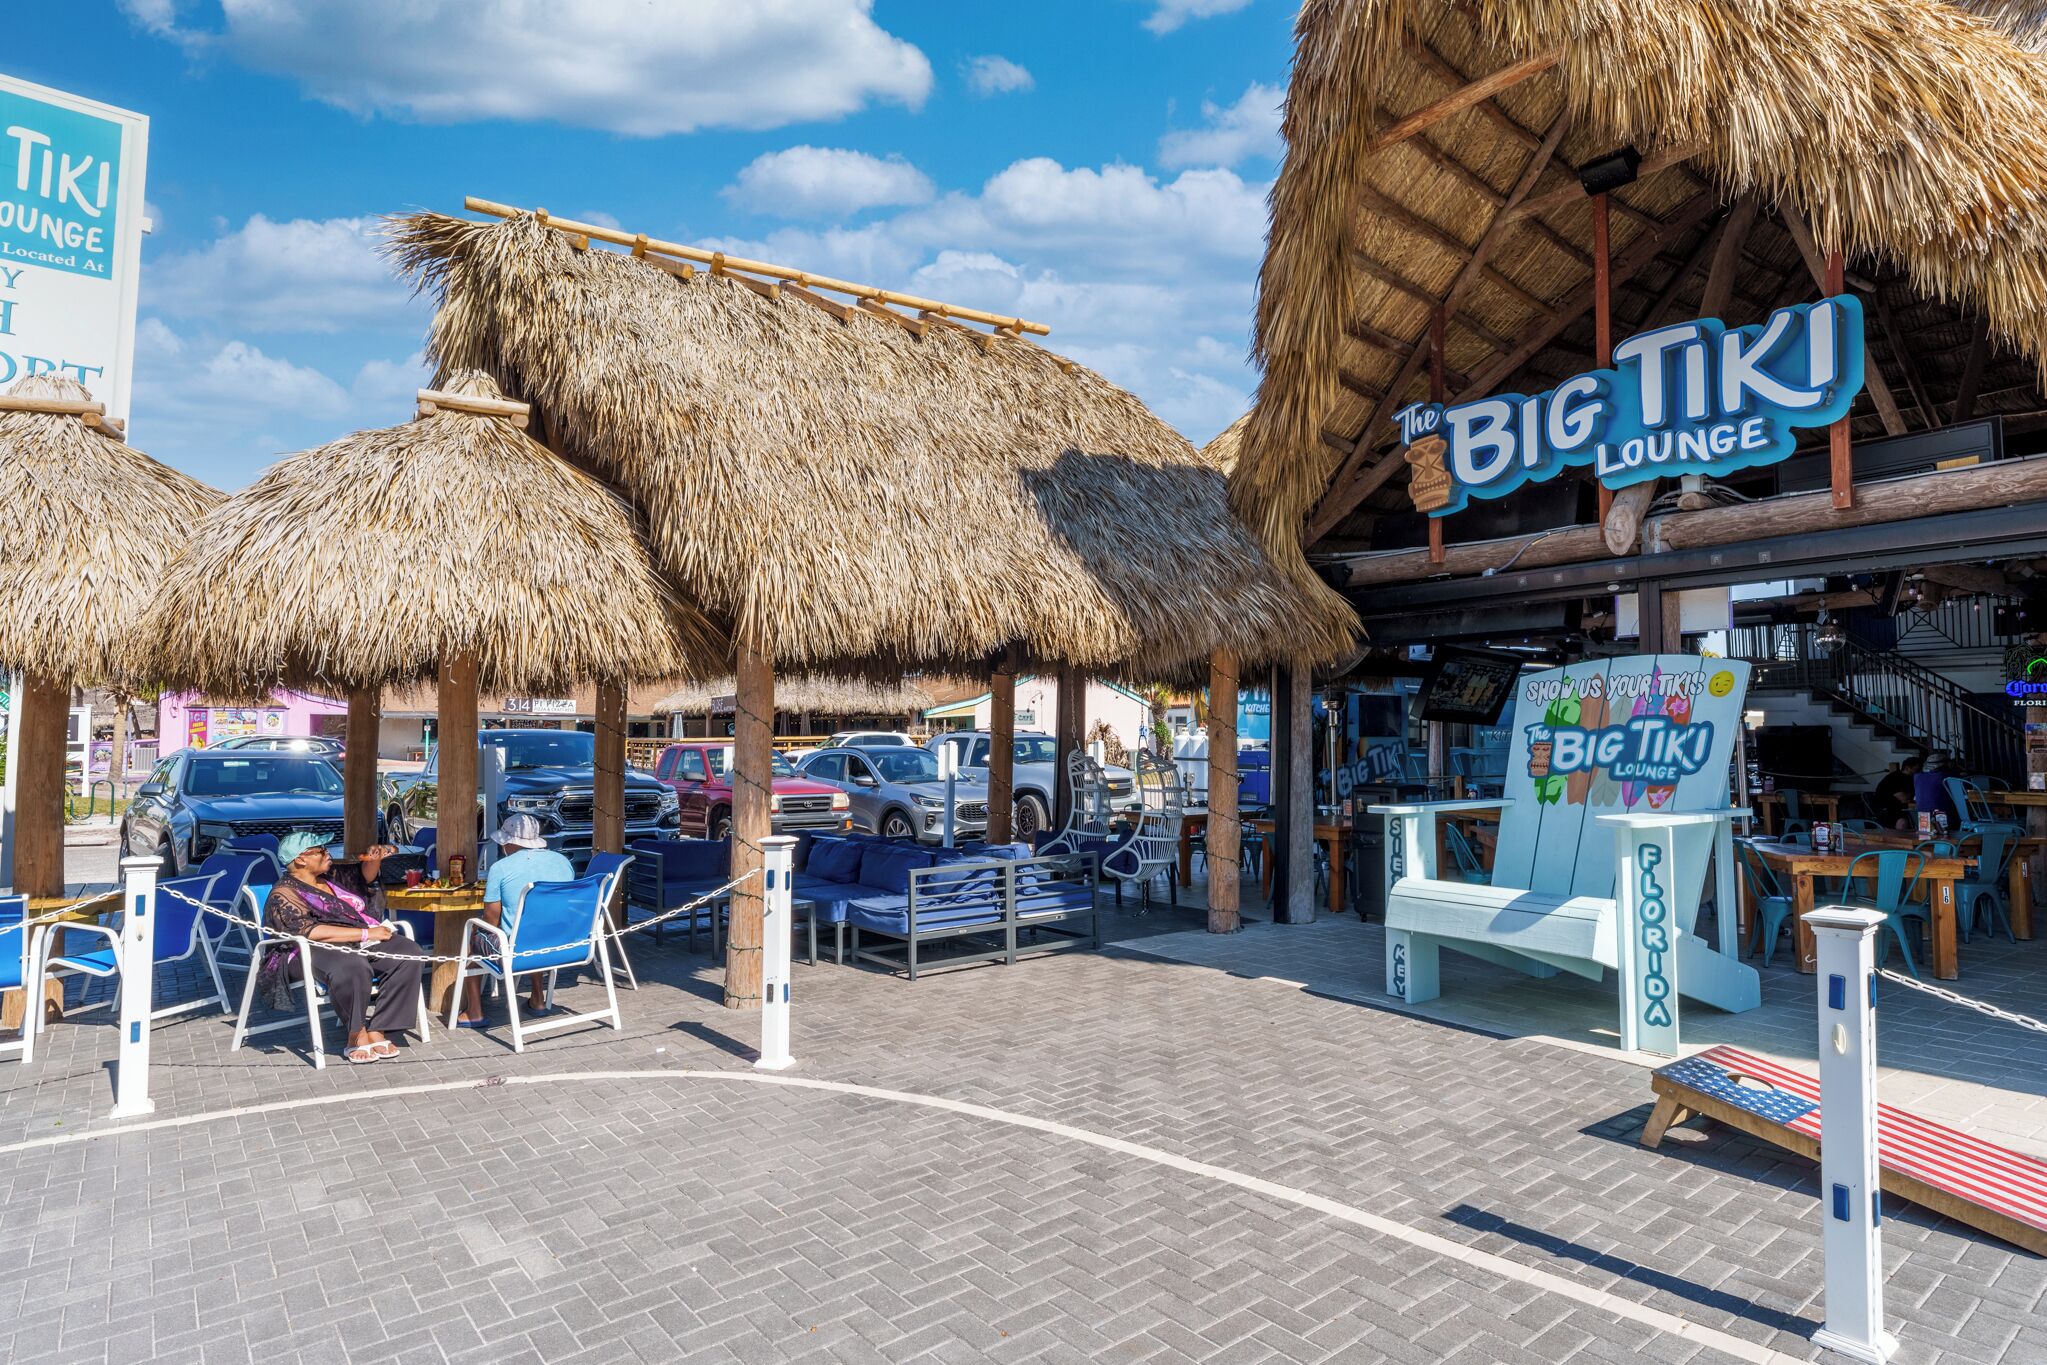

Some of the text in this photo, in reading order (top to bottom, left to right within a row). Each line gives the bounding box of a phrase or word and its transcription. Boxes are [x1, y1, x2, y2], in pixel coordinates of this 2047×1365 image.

[6, 125, 110, 218] TIKI
[2, 241, 105, 273] Located At
[1394, 299, 1836, 486] The BIG TIKI
[1595, 416, 1770, 477] LOUNGE
[507, 698, 531, 712] 3.14
[1526, 678, 1577, 706] SHOW
[1578, 677, 1602, 699] US
[1606, 674, 1653, 704] YOUR
[1527, 719, 1708, 771] The BIG TIKI
[1615, 763, 1678, 779] LOUNGE
[1638, 843, 1672, 1027] FLORIDA
